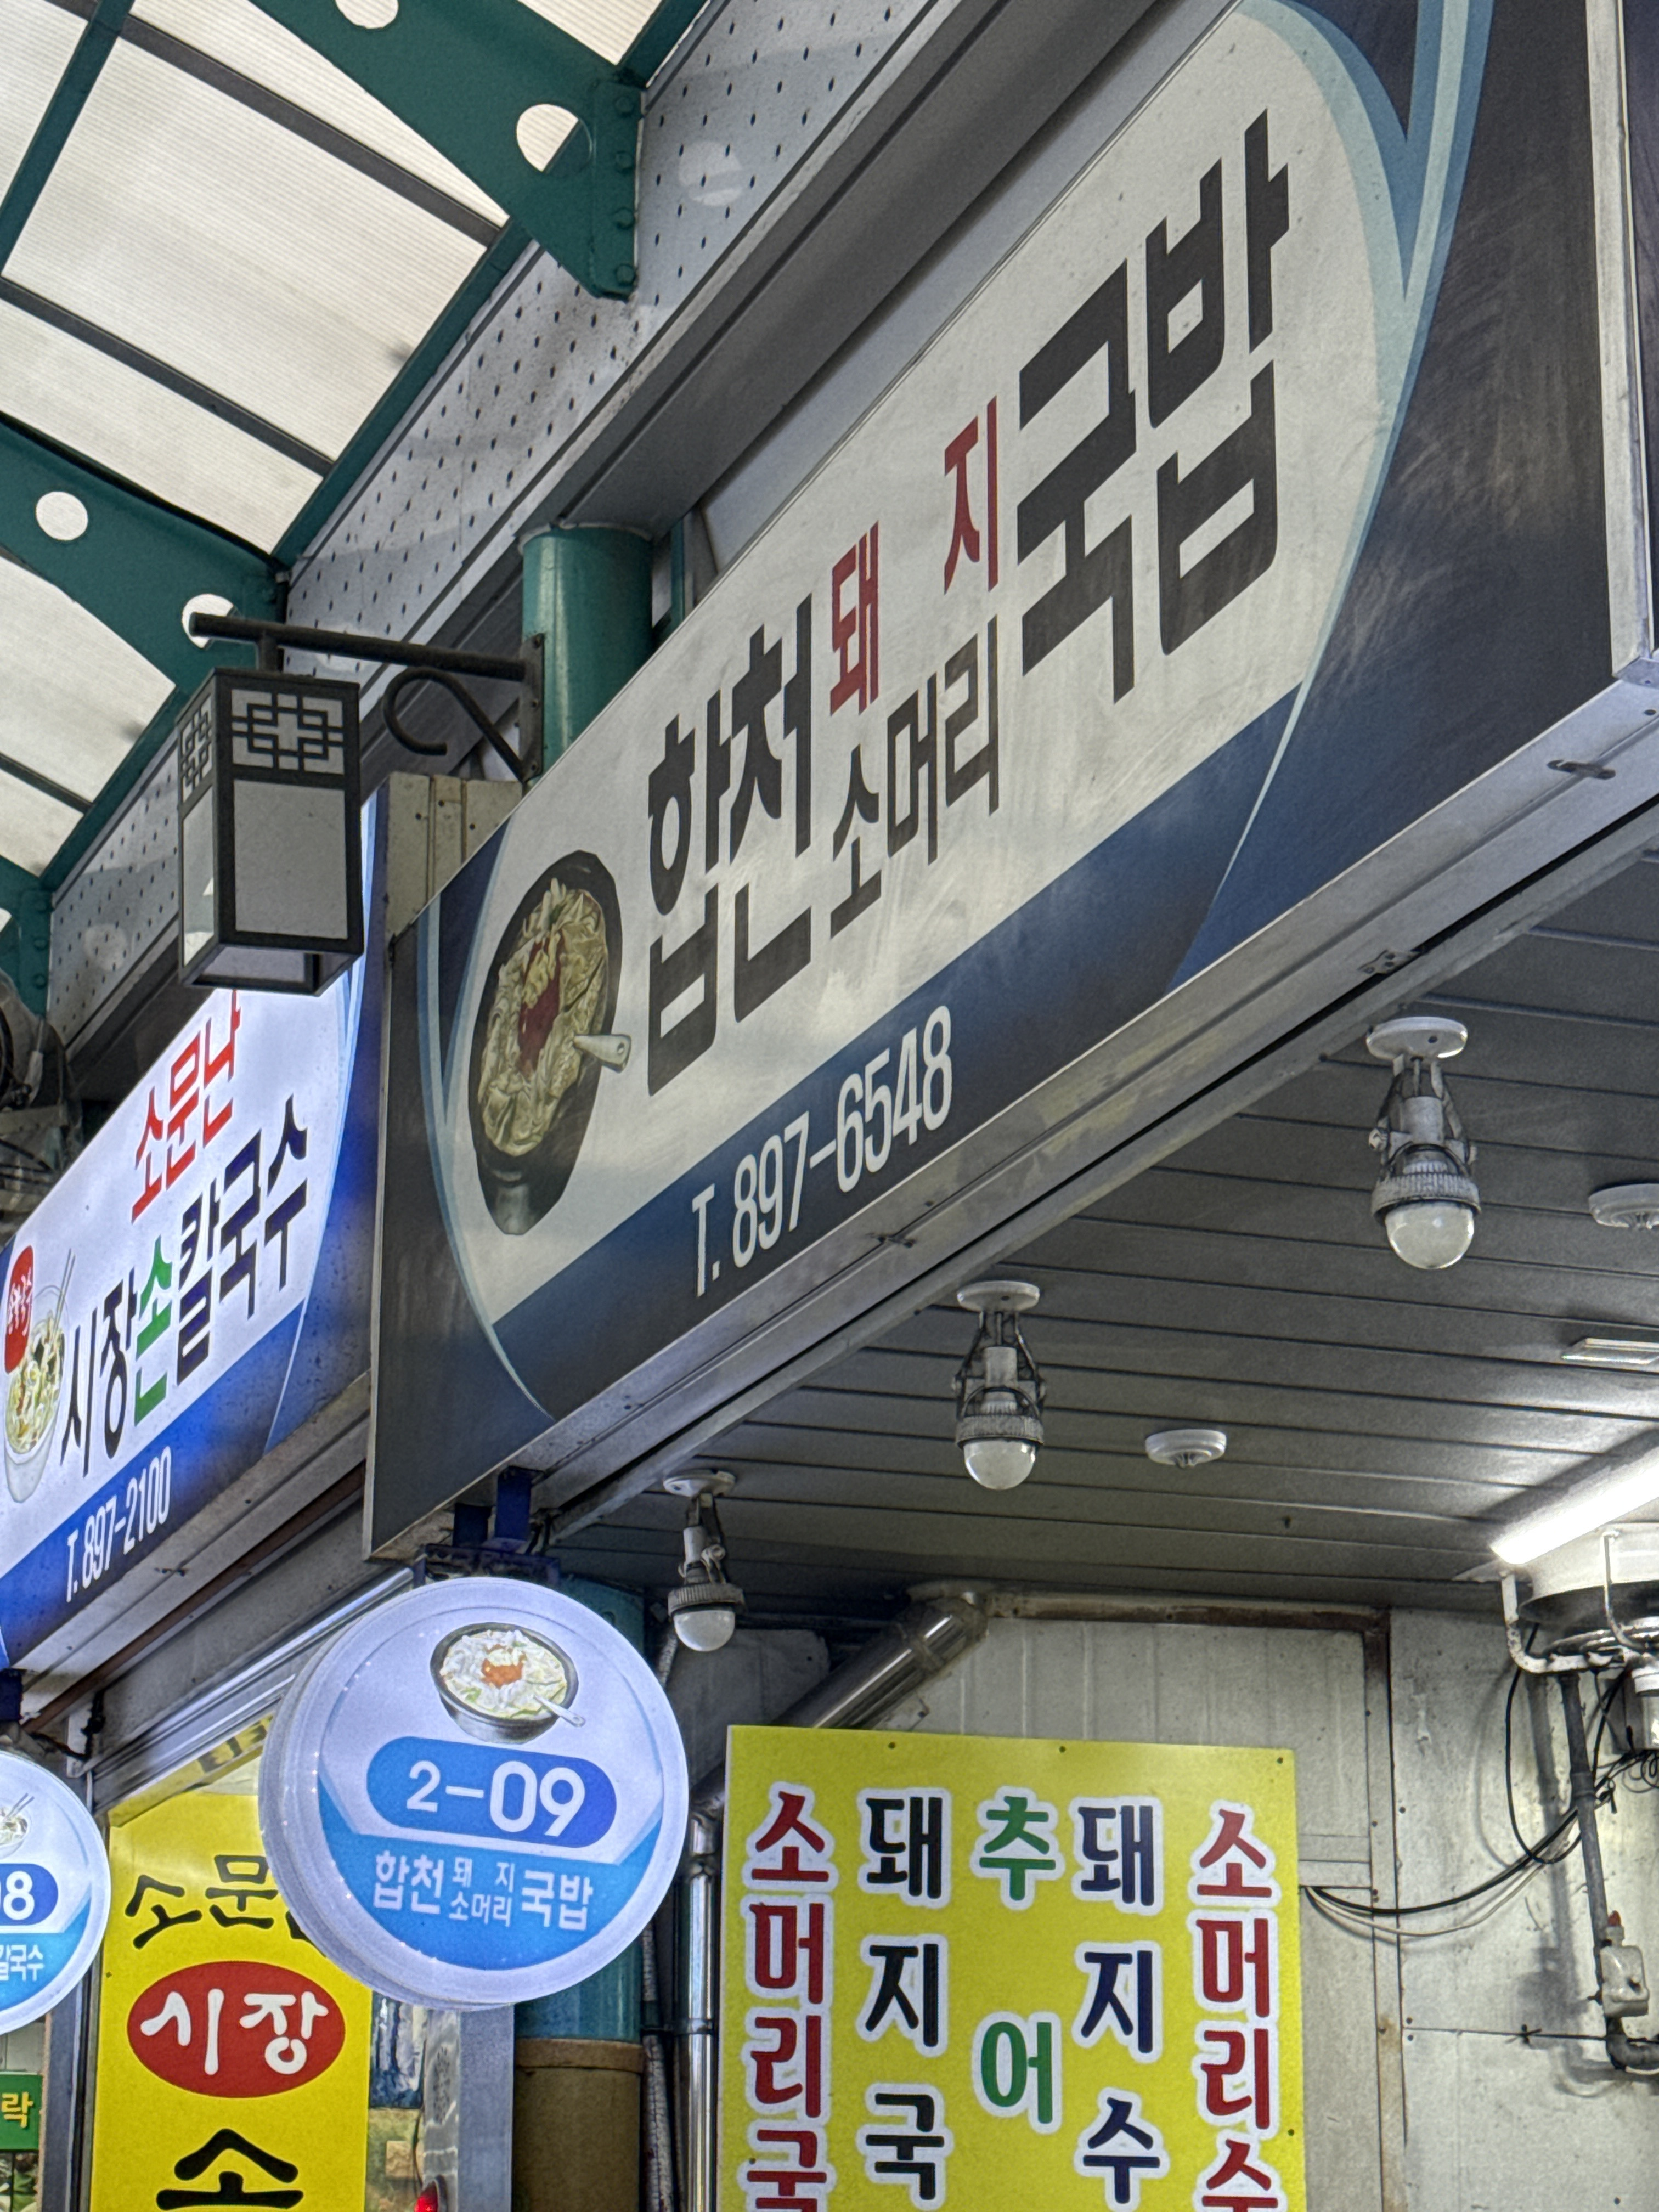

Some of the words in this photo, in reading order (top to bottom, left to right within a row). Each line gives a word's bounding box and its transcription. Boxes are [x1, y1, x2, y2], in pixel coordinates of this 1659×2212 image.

[830, 614, 1000, 938] 소머리
[131, 991, 241, 1223] 소문난
[692, 1005, 952, 1297] T.897-6548
[66, 1446, 171, 1602] T.897-2100
[407, 1760, 585, 1837] 2-09
[0, 1871, 35, 1921] 8
[125, 1855, 326, 1957] 소문
[373, 1850, 444, 1914] 합천
[521, 1870, 594, 1931] 국밥
[449, 1891, 512, 1927] 소머리
[452, 1857, 515, 1893] 돼지
[140, 1989, 329, 2076] 시장
